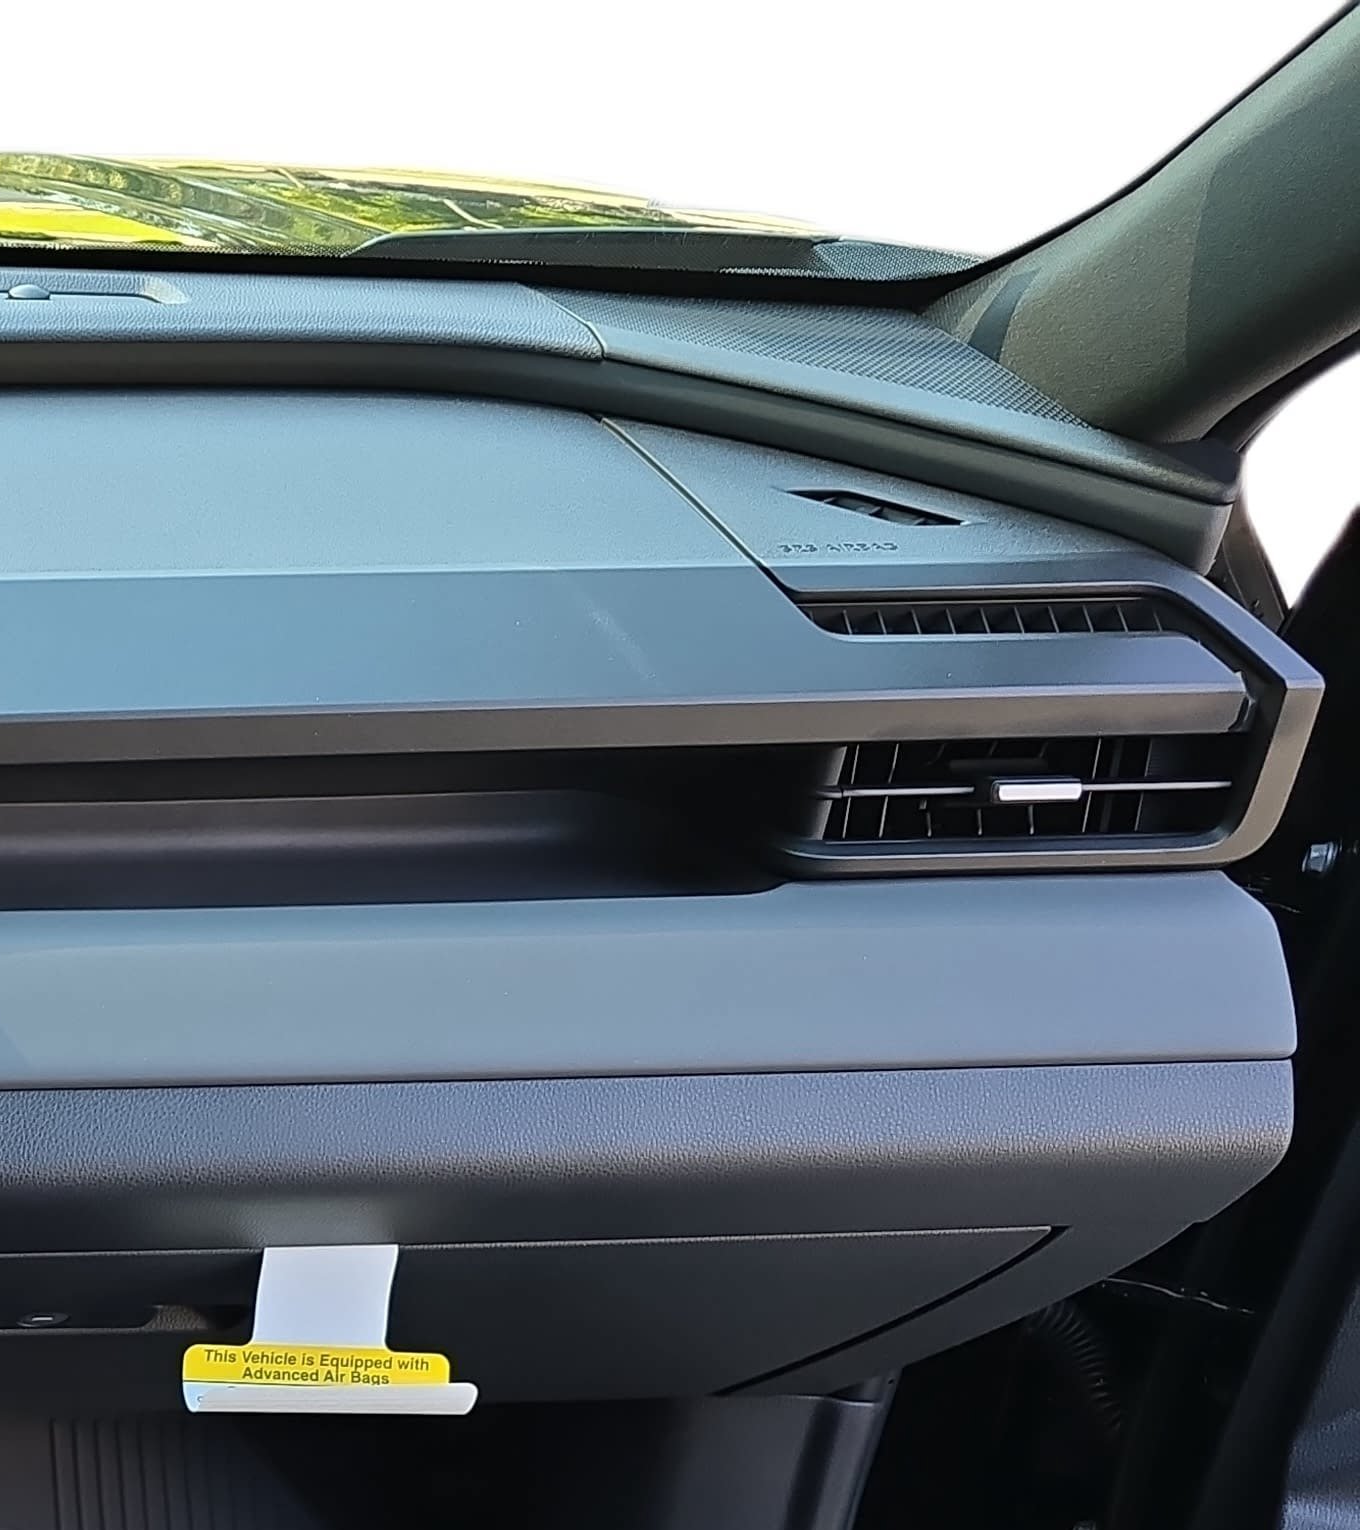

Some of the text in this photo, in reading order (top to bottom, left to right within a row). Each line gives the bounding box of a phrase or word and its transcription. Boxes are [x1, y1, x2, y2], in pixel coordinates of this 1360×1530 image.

[204, 1349, 429, 1373] This Vehicle is Equipped with
[242, 1367, 390, 1385] Advanced Air Bags
